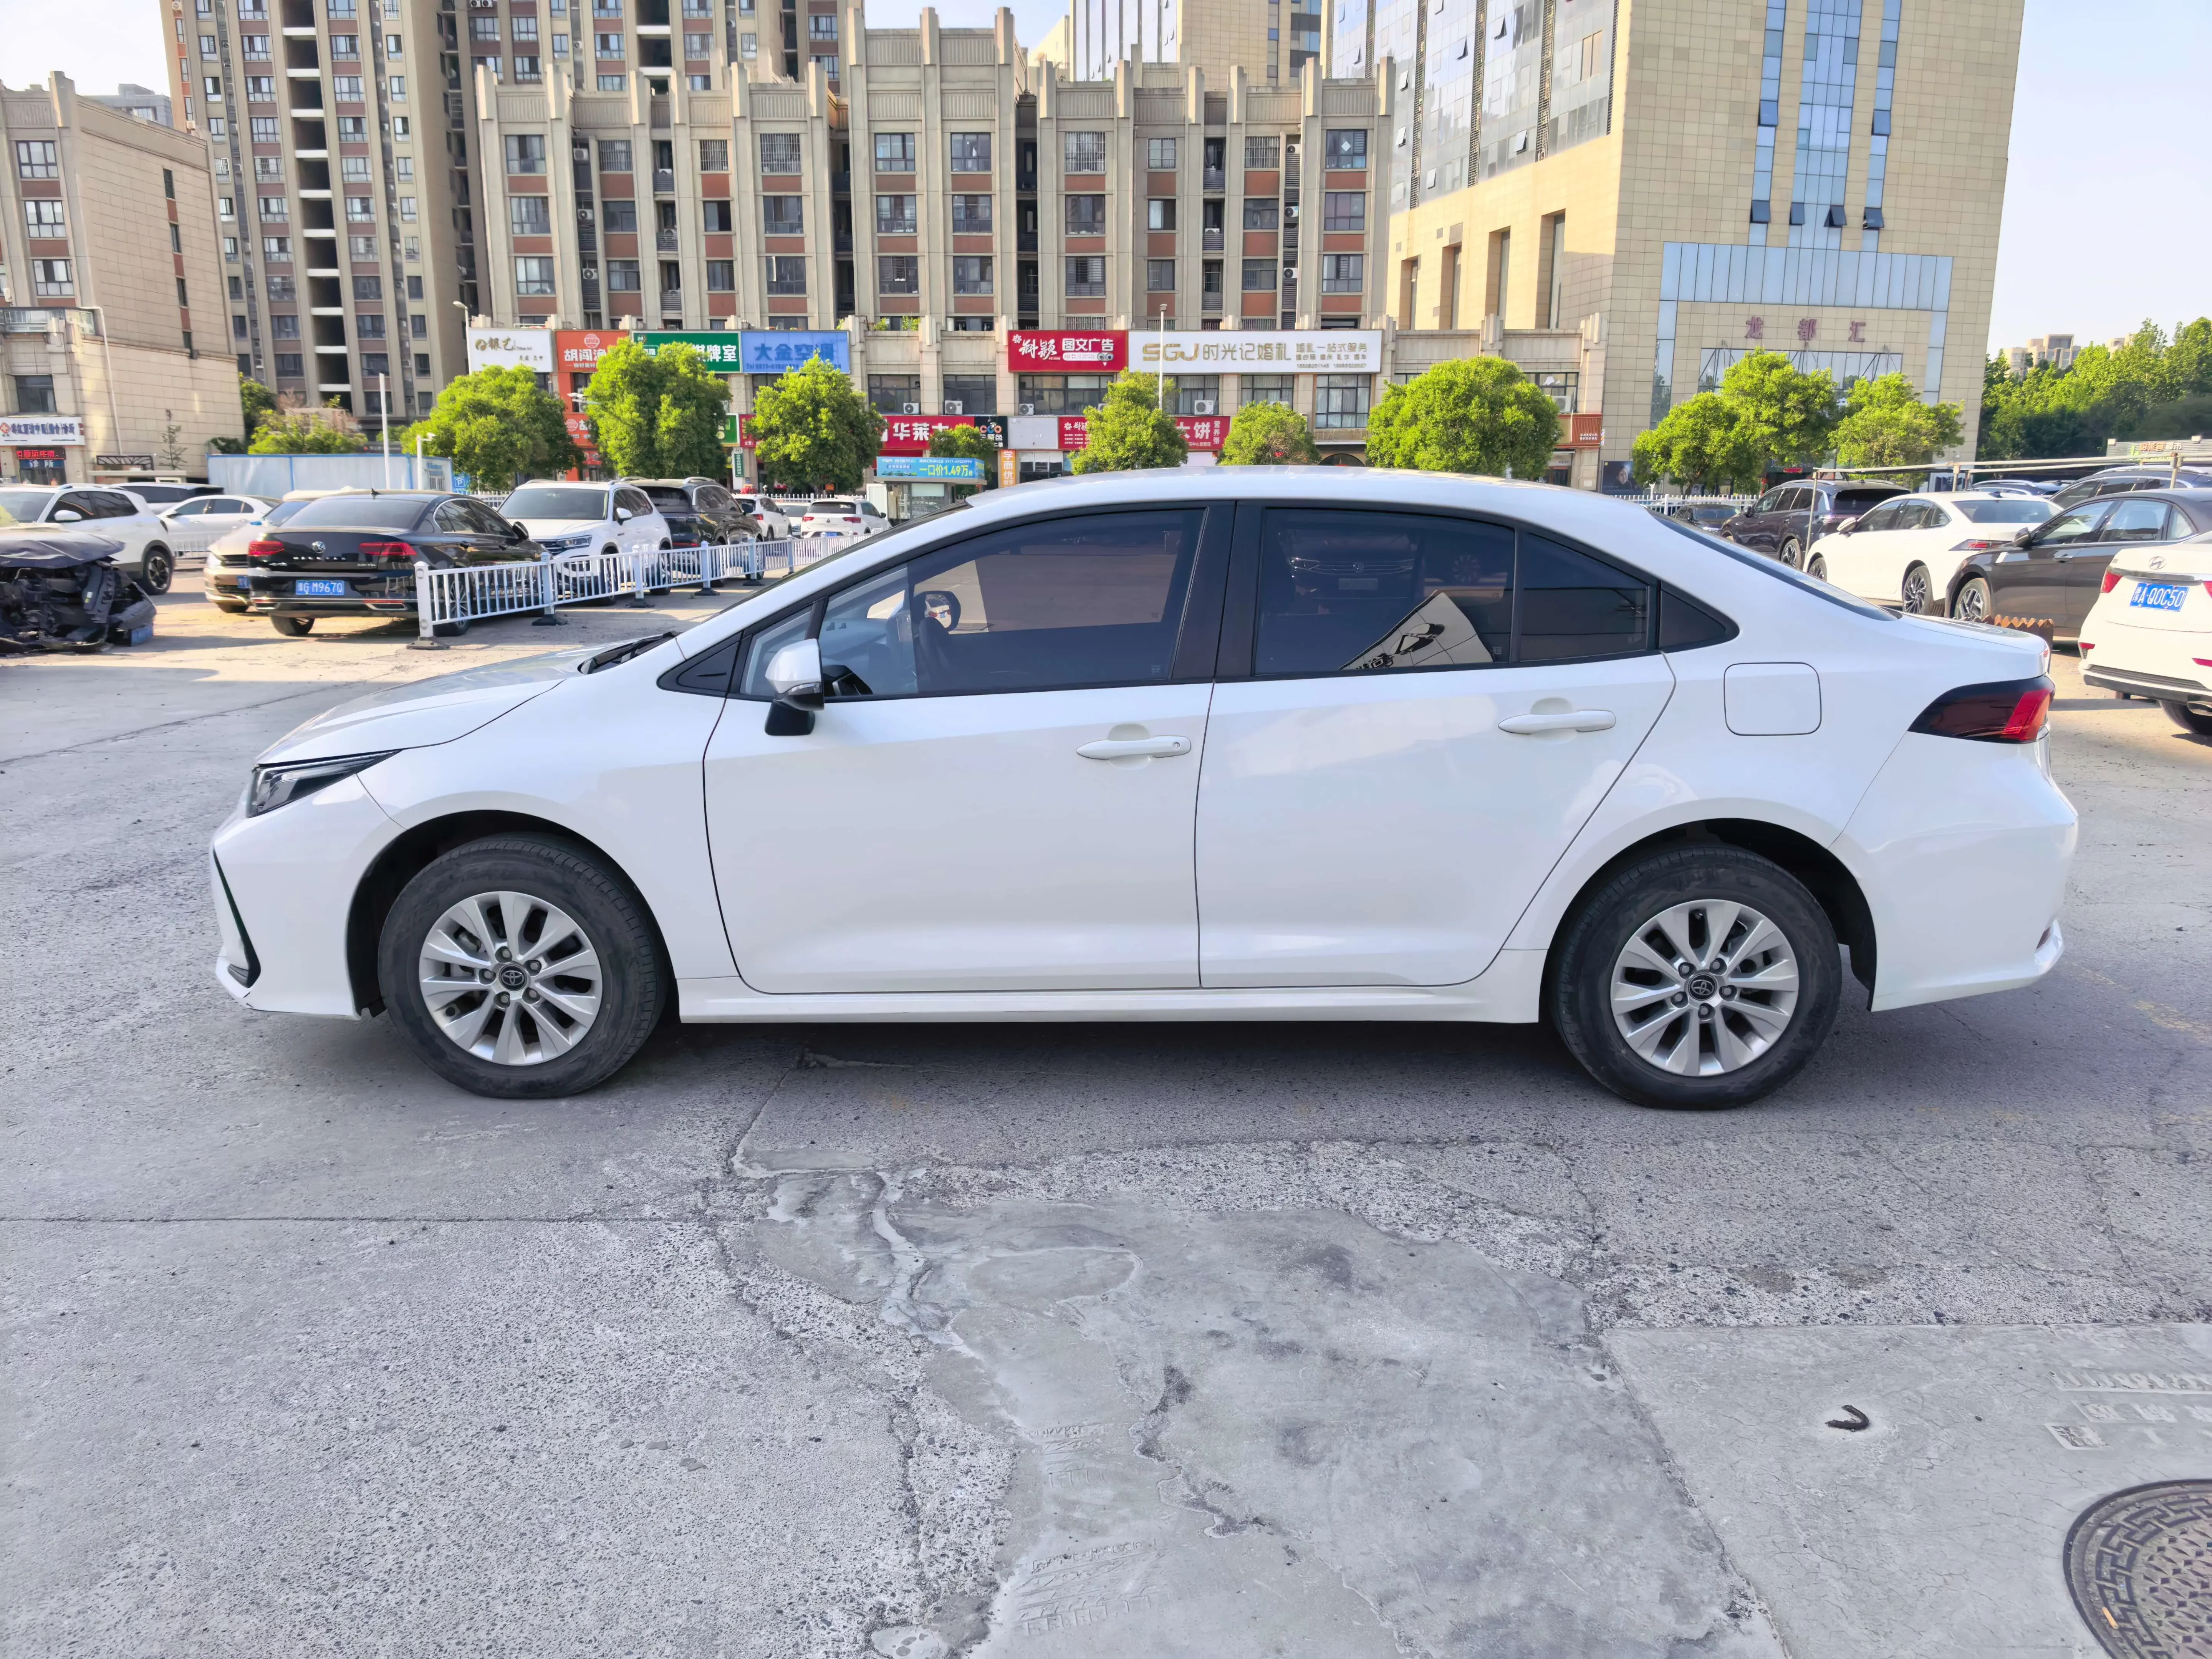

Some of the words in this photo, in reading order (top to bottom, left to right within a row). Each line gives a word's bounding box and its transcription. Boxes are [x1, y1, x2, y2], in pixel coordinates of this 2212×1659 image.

[1745, 316, 1866, 342] 龙都汇
[1062, 338, 1114, 351] 图文广告
[1202, 343, 1291, 361] 时光记婚礼
[1296, 343, 1368, 353] 婚礼一站式服务
[1003, 451, 1013, 480] 学而优
